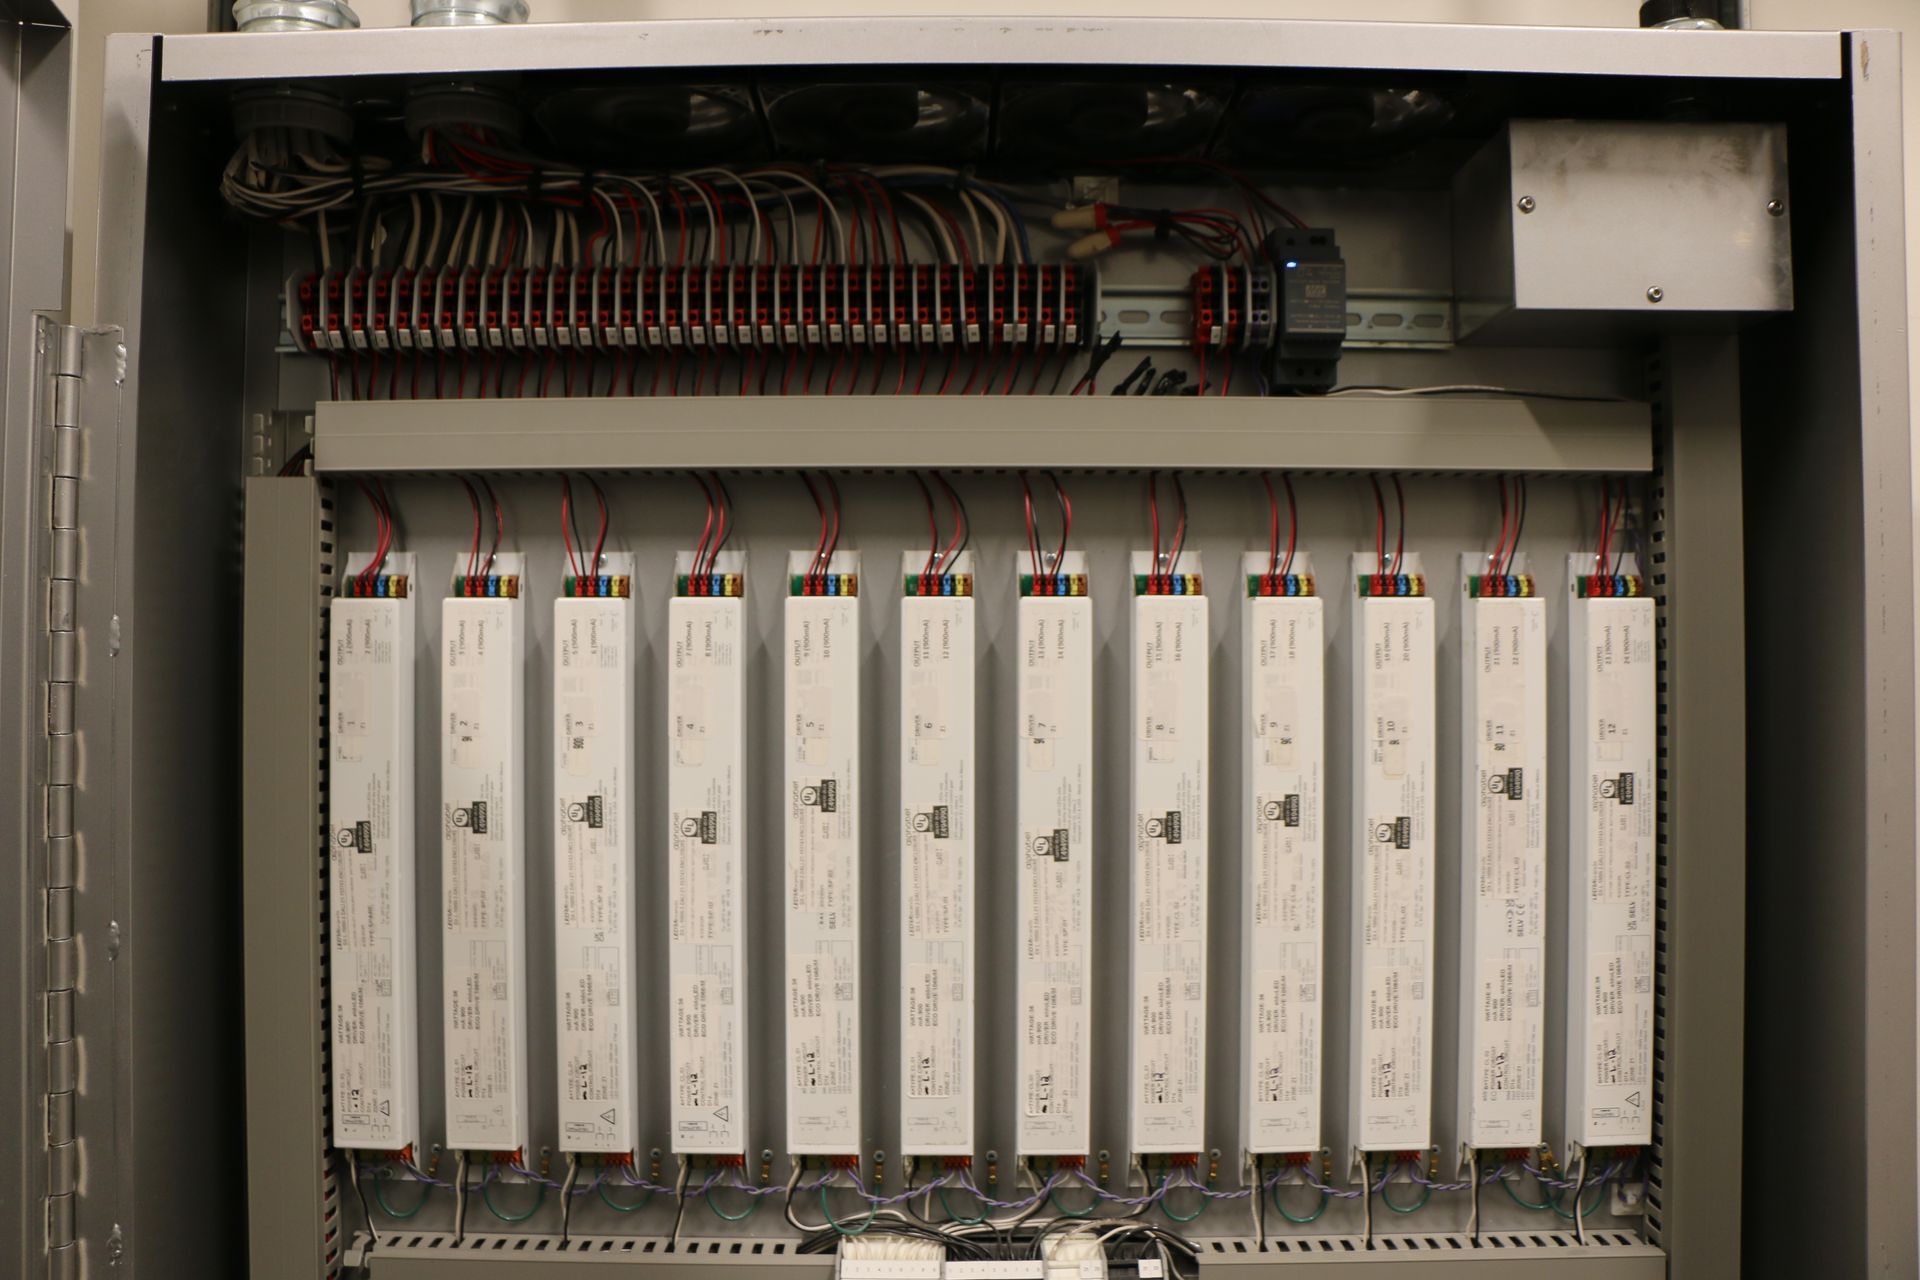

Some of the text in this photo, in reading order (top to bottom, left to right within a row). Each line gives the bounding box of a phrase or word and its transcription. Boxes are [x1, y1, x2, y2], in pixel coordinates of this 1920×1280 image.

[1387, 720, 1395, 732] 10
[1496, 725, 1504, 735] 11
[1608, 723, 1616, 734] 12
